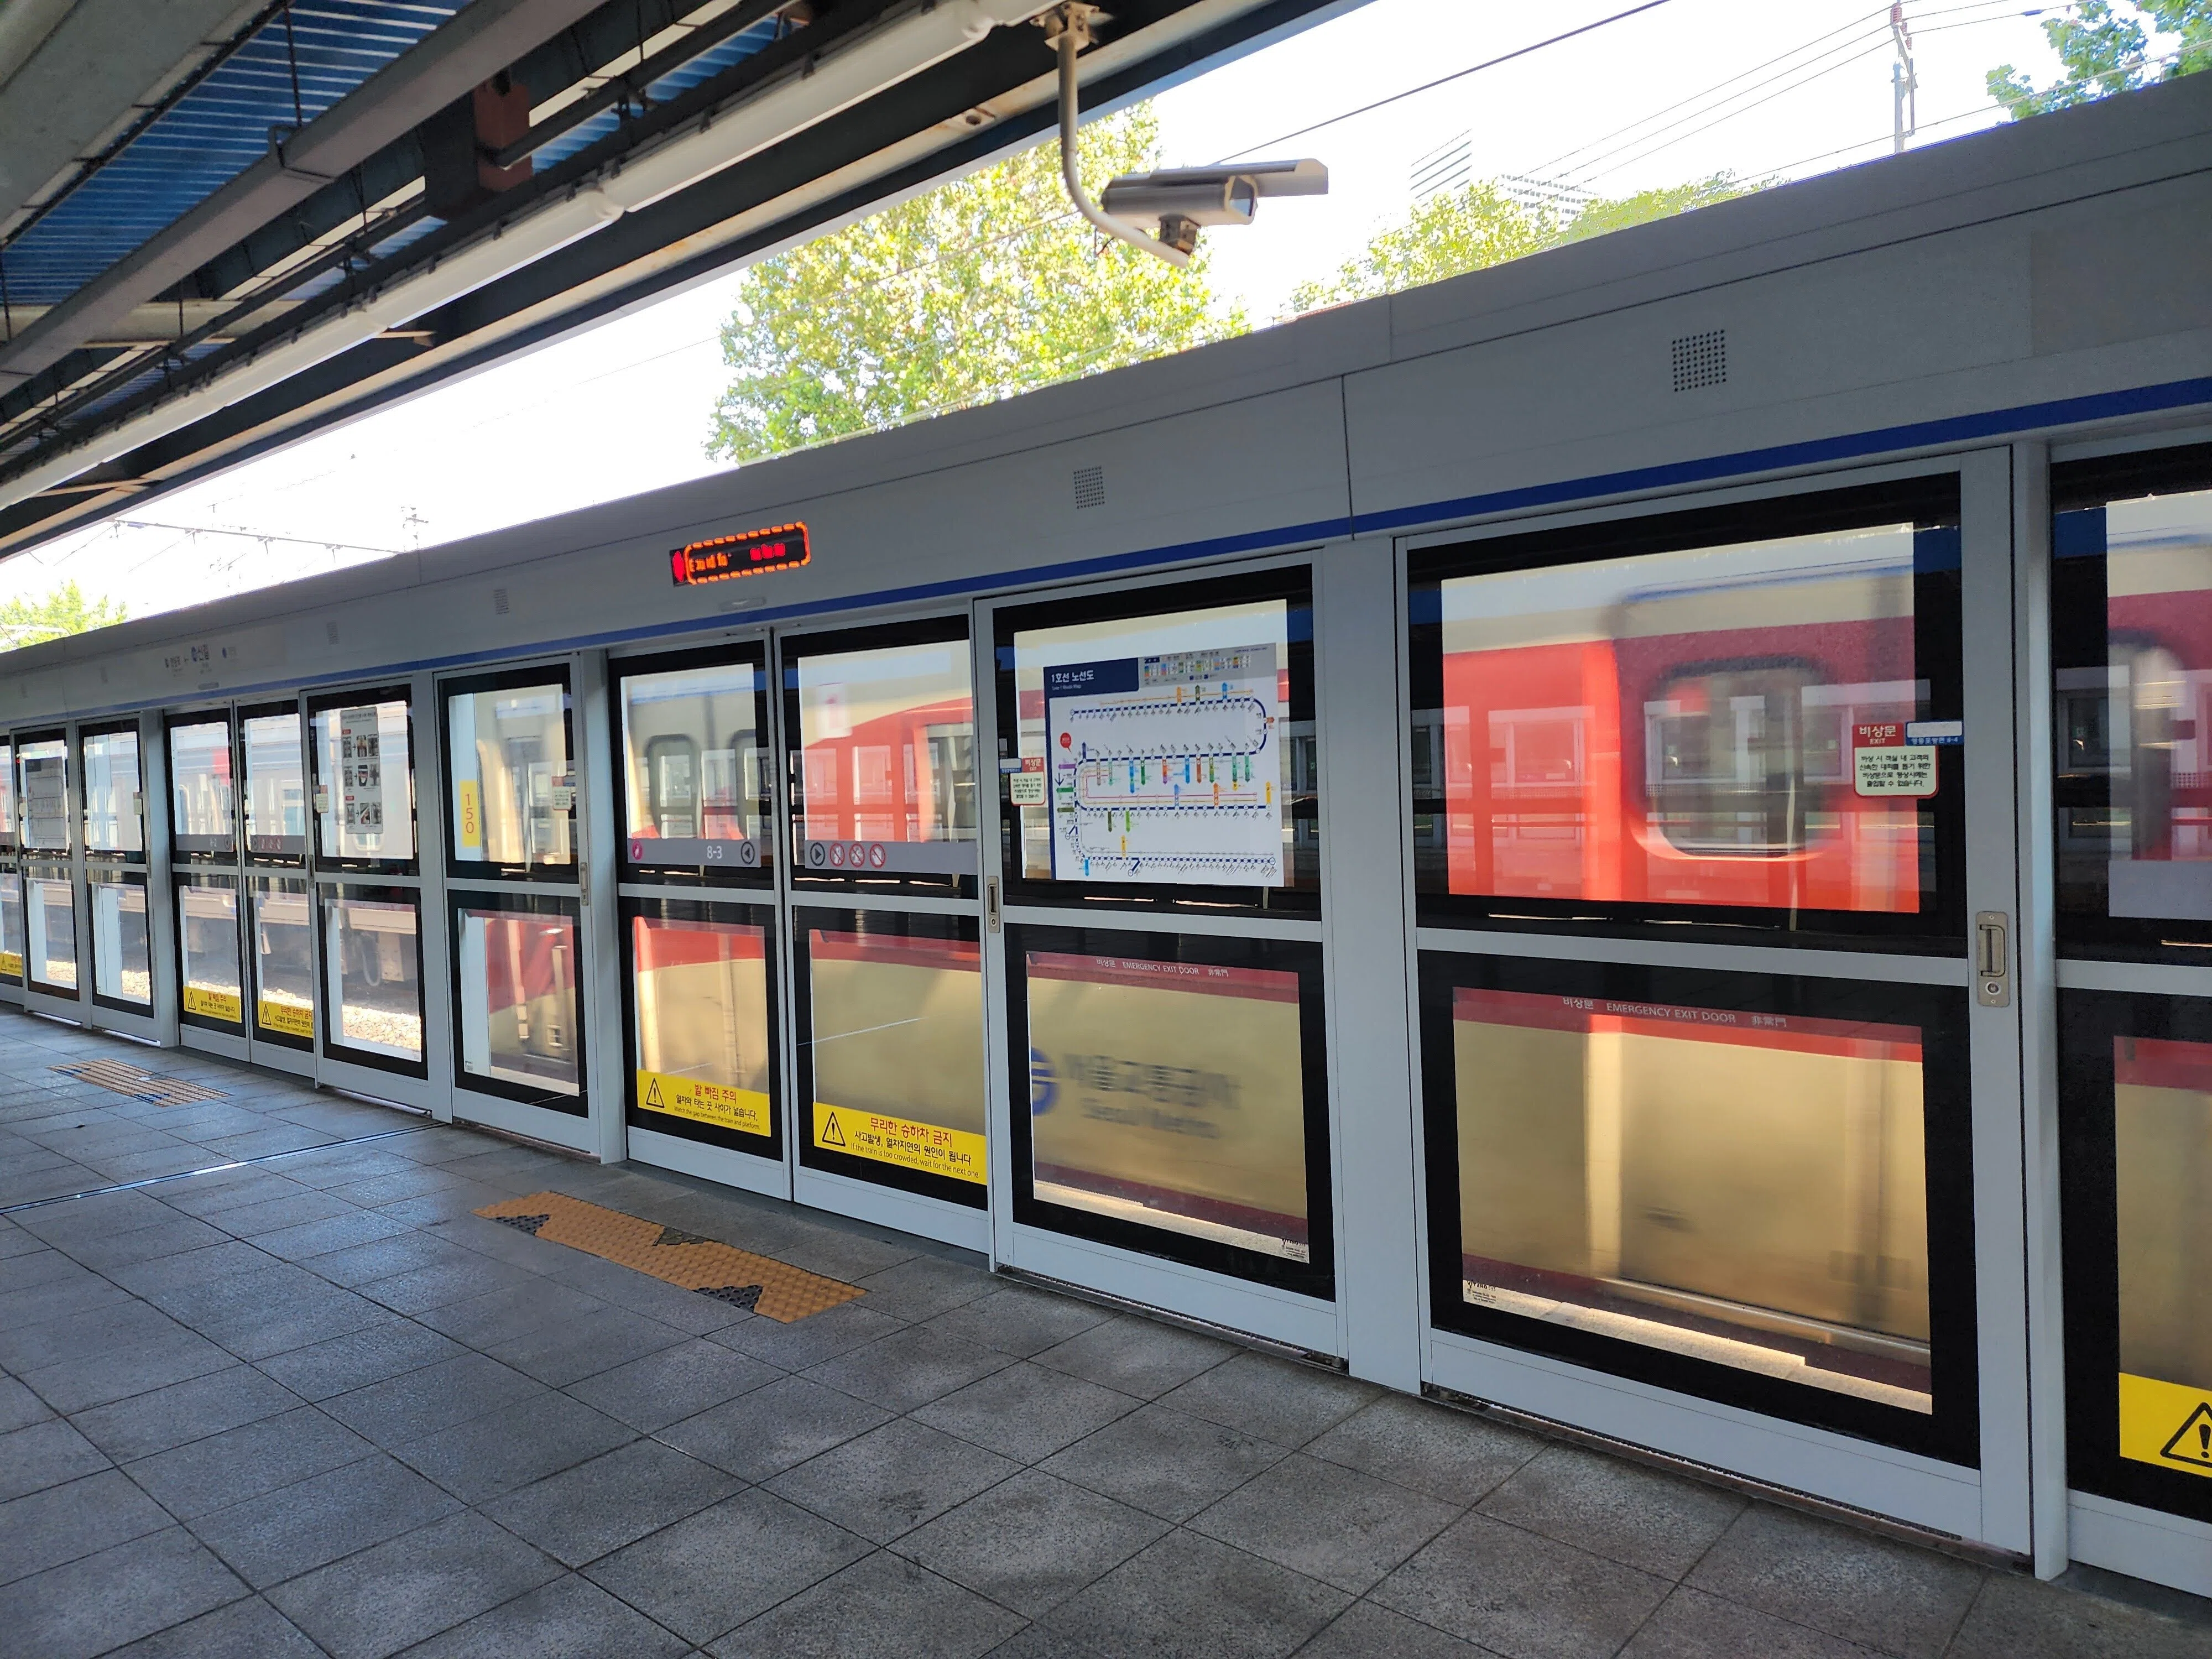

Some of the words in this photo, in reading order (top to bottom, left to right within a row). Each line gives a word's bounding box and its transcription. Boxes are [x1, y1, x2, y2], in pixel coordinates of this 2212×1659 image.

[1051, 672, 1070, 683] 1호선
[1072, 670, 1094, 681] 노선도
[1859, 725, 1896, 737] 비상문
[465, 793, 474, 833] 150
[707, 845, 722, 859] 8-3
[1123, 962, 1161, 972] EMERGENCY
[1163, 964, 1176, 973] EXIT
[1178, 967, 1199, 975] DOOR
[1562, 997, 1594, 1010] 비상문
[1606, 1002, 1671, 1017] EMERGENCY
[1674, 1009, 1698, 1020] EXIT
[1702, 1011, 1736, 1024] DOOR
[695, 1084, 702, 1097] 발
[705, 1086, 718, 1100] 빠짐
[722, 1089, 737, 1104] 주의
[676, 1094, 692, 1106] 열차와
[694, 1098, 705, 1109] 타는
[707, 1101, 712, 1111] 곳
[714, 1103, 731, 1115] 사이가
[870, 1117, 898, 1136] 무리한
[901, 1124, 930, 1142] 승하차
[933, 1130, 952, 1147] 금지
[855, 1131, 883, 1147] 사고발생,
[886, 1137, 921, 1155] 열차지연의
[924, 1145, 946, 1160] 원인이
[948, 1151, 971, 1166] 됩니다
[855, 1144, 864, 1152] the
[865, 1146, 877, 1155] train
[894, 1152, 919, 1166] crowded,
[920, 1159, 932, 1167] wait
[933, 1161, 942, 1170] for
[942, 1163, 952, 1172] the
[953, 1167, 967, 1175] next
[967, 1170, 979, 1178] one
